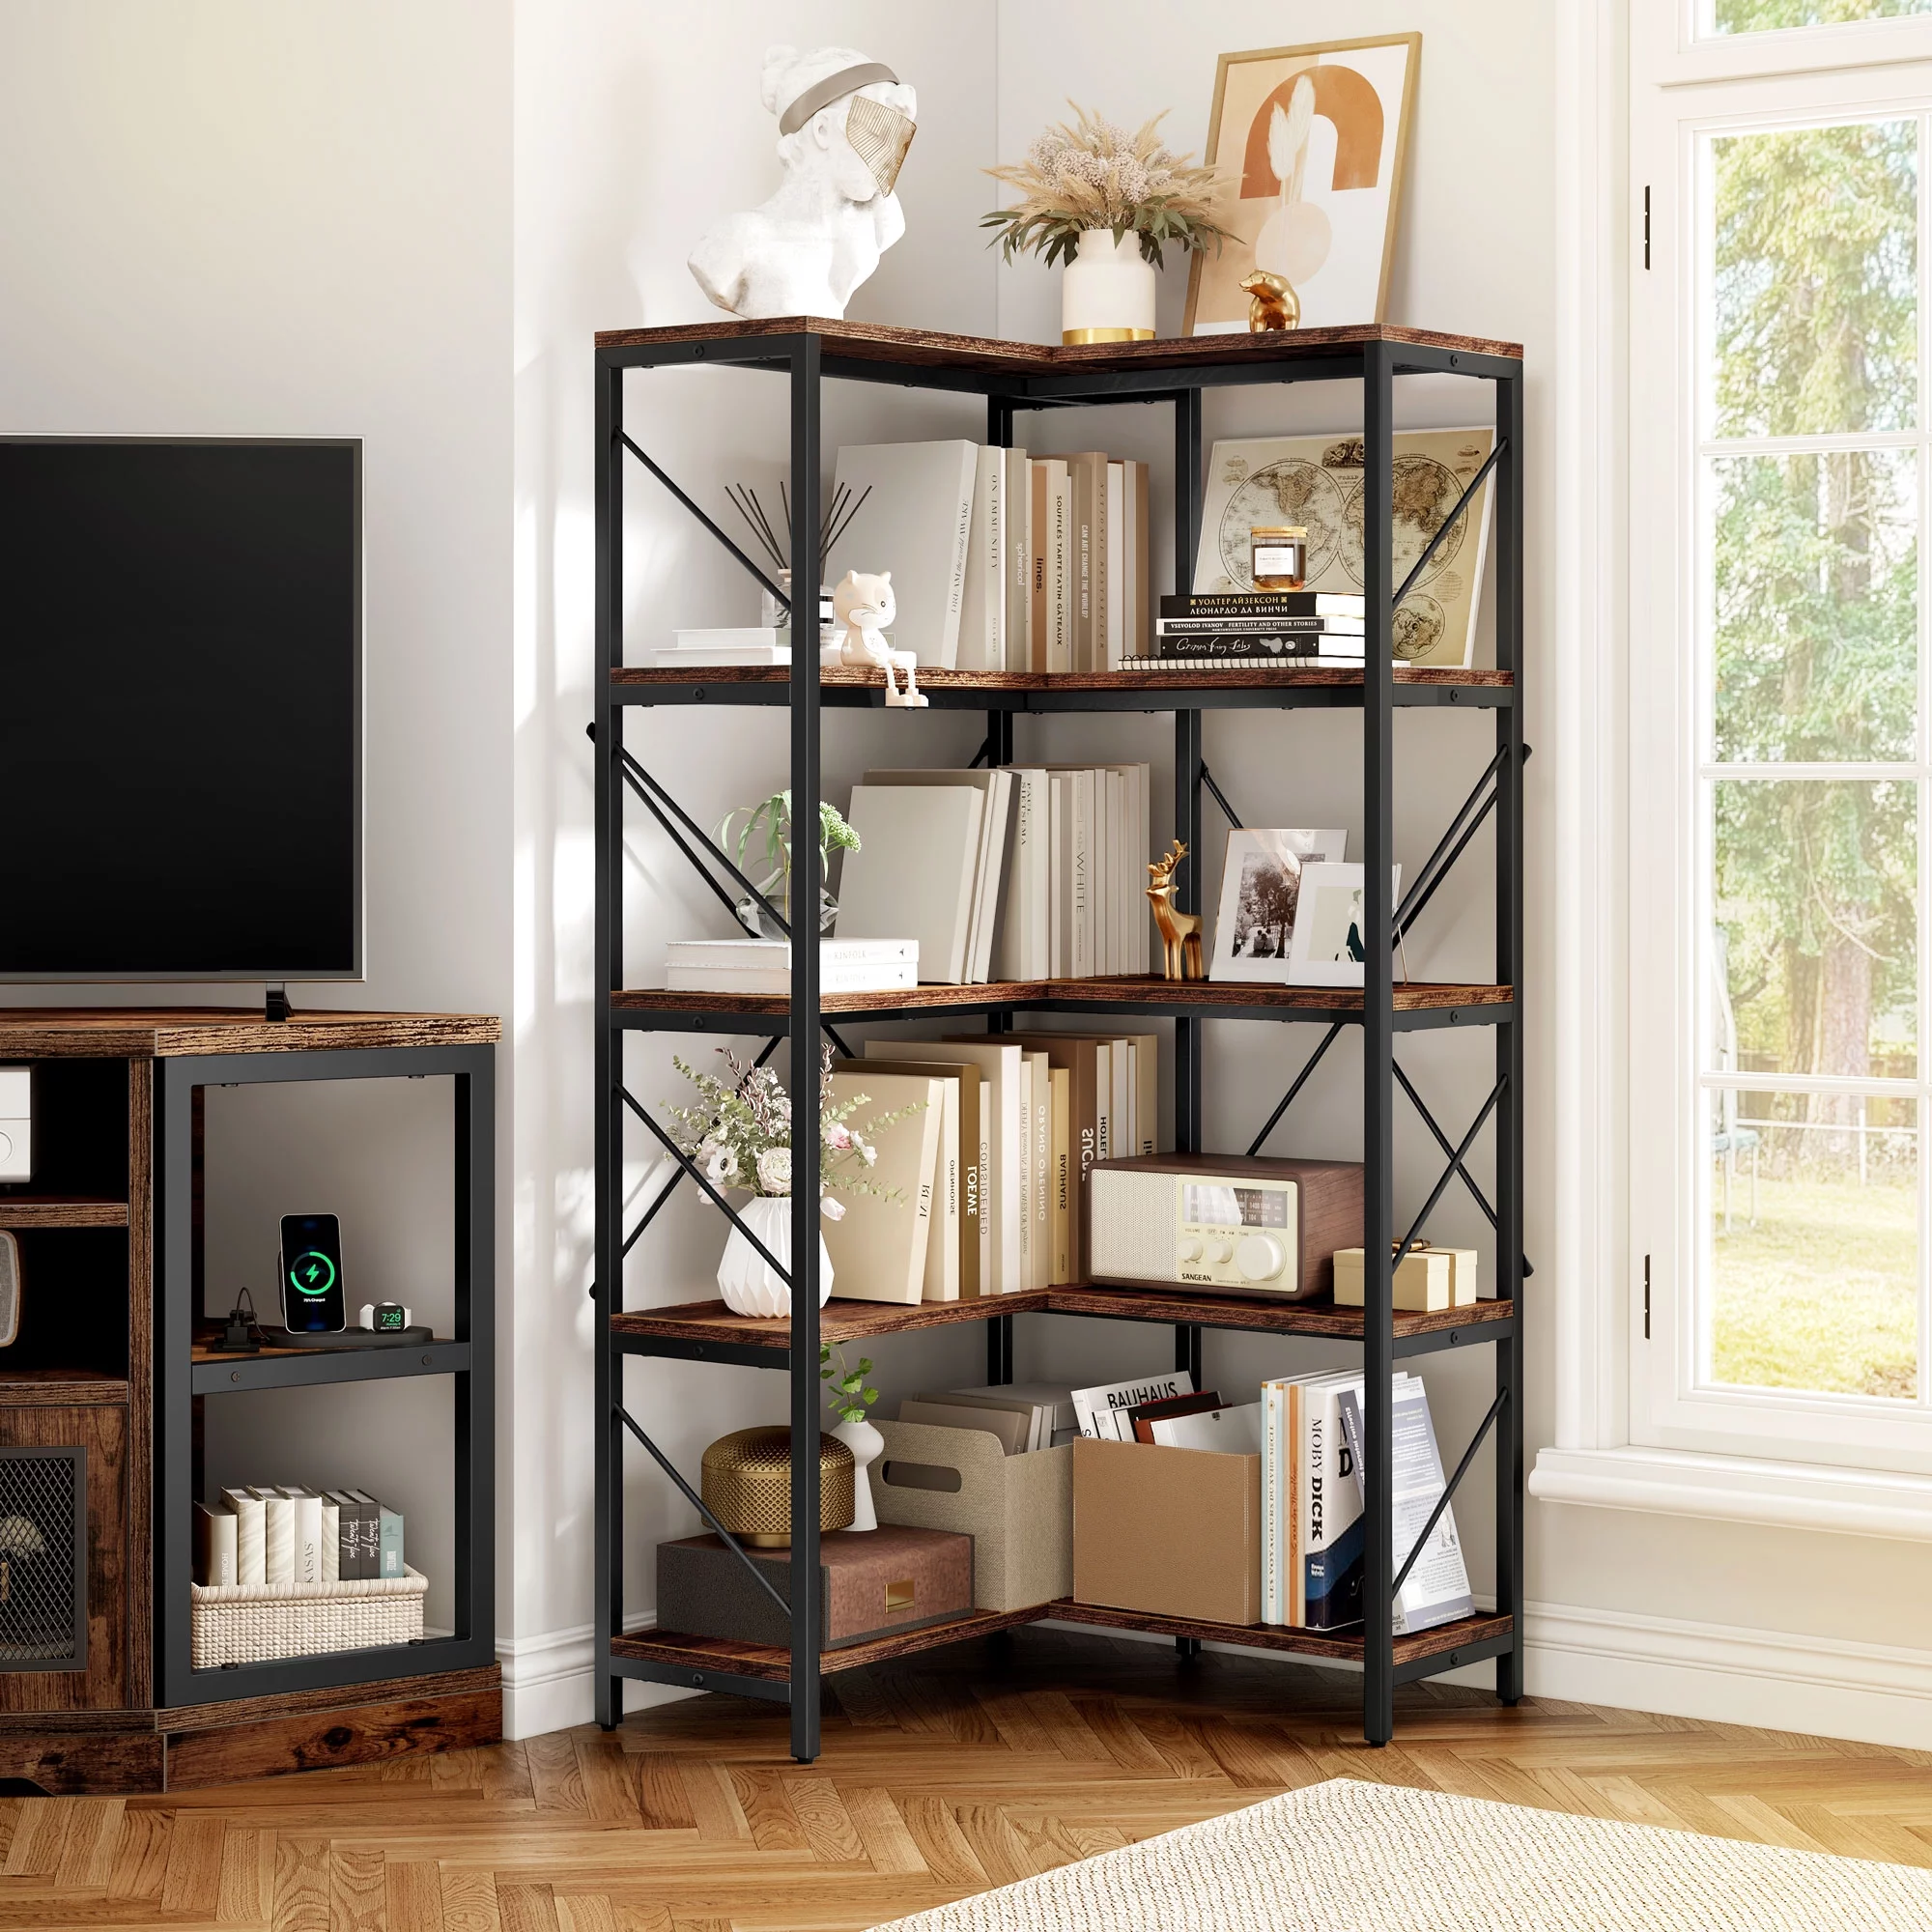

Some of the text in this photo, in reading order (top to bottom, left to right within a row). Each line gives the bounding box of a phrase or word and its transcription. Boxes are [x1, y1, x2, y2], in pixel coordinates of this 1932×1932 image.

[991, 474, 997, 493] ON
[951, 573, 961, 612] DREAM
[960, 498, 969, 537] AWAKE
[1016, 542, 1026, 585] spherical
[1036, 557, 1044, 593] lines.
[1190, 607, 1238, 615] ЛЕОНАРДО
[1255, 605, 1288, 613] ВИНЧИ
[1233, 595, 1279, 605] АЙЗЕКСОН
[1056, 603, 1065, 645] GÂTEAUX
[1076, 852, 1085, 914] WHITE
[1181, 1273, 1212, 1282] SANGEAN
[382, 1313, 402, 1322] 7:29
[1107, 1381, 1179, 1409] BAUHAUS
[1312, 1418, 1322, 1542] MOBY DICK
